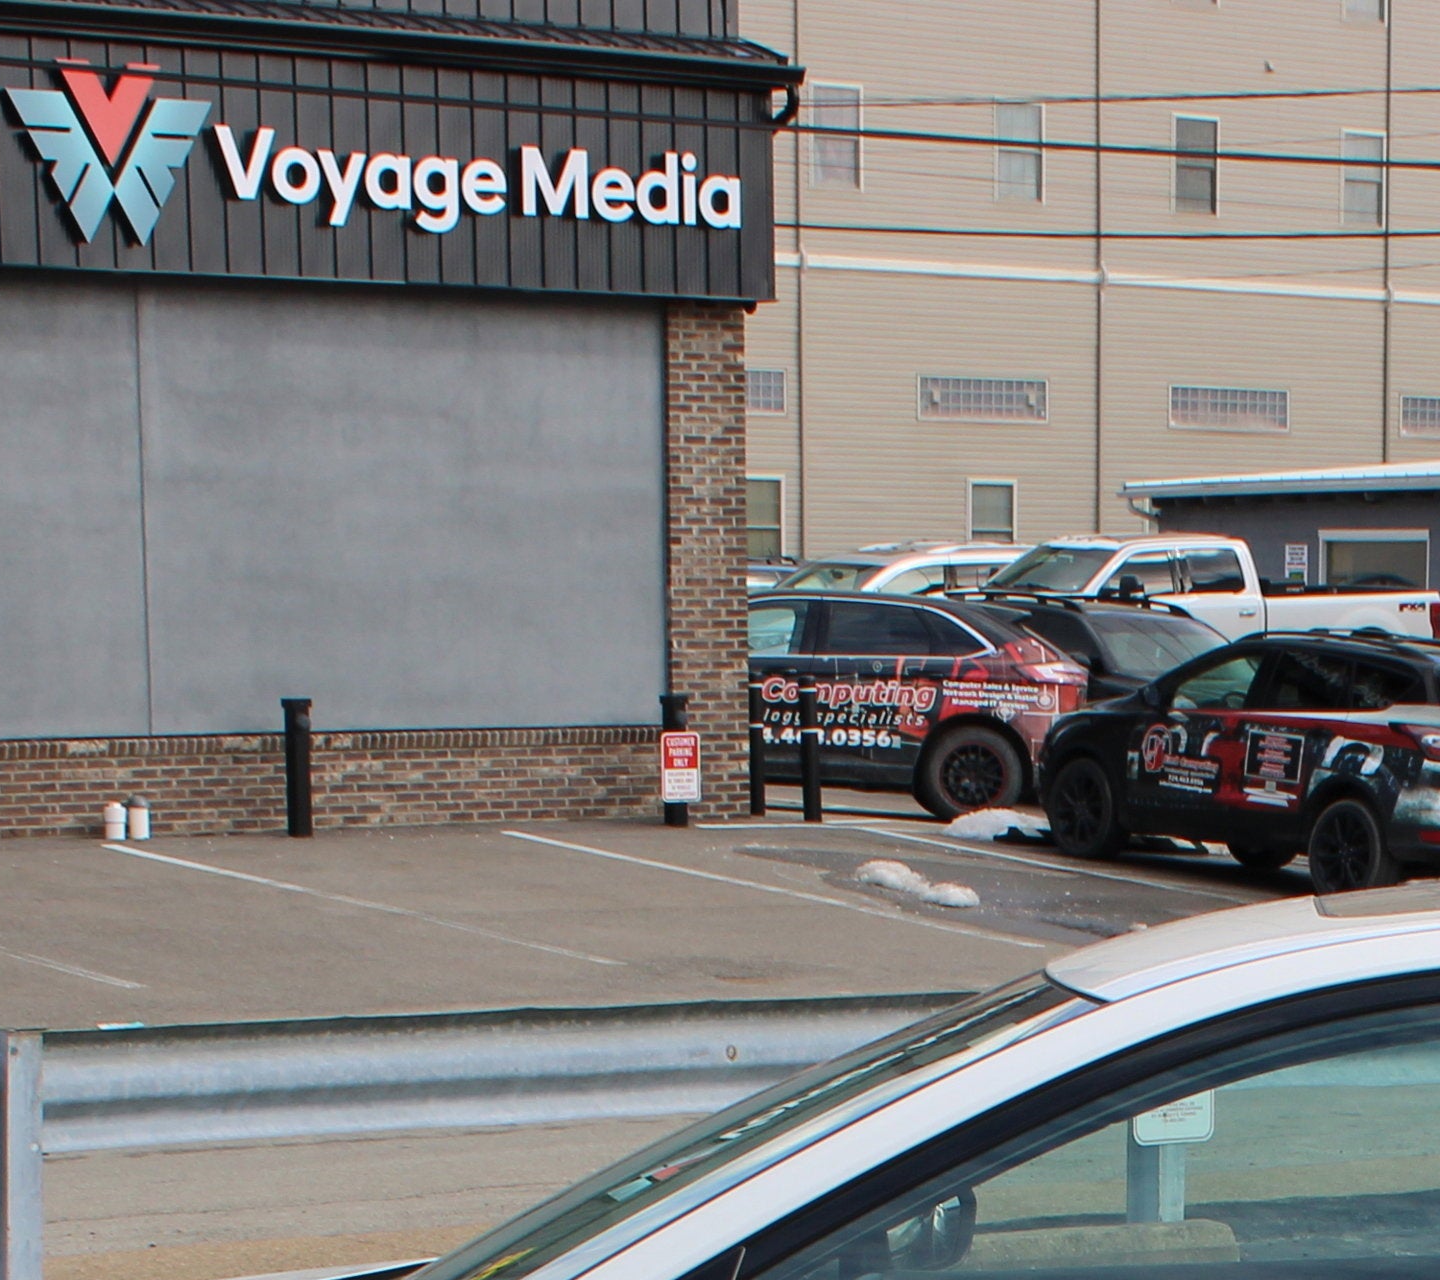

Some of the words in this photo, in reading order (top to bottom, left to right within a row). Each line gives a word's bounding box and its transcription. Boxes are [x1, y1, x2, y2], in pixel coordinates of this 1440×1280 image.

[213, 123, 507, 234] Voyage
[520, 145, 743, 230] Media
[673, 758, 688, 767] ONLY
